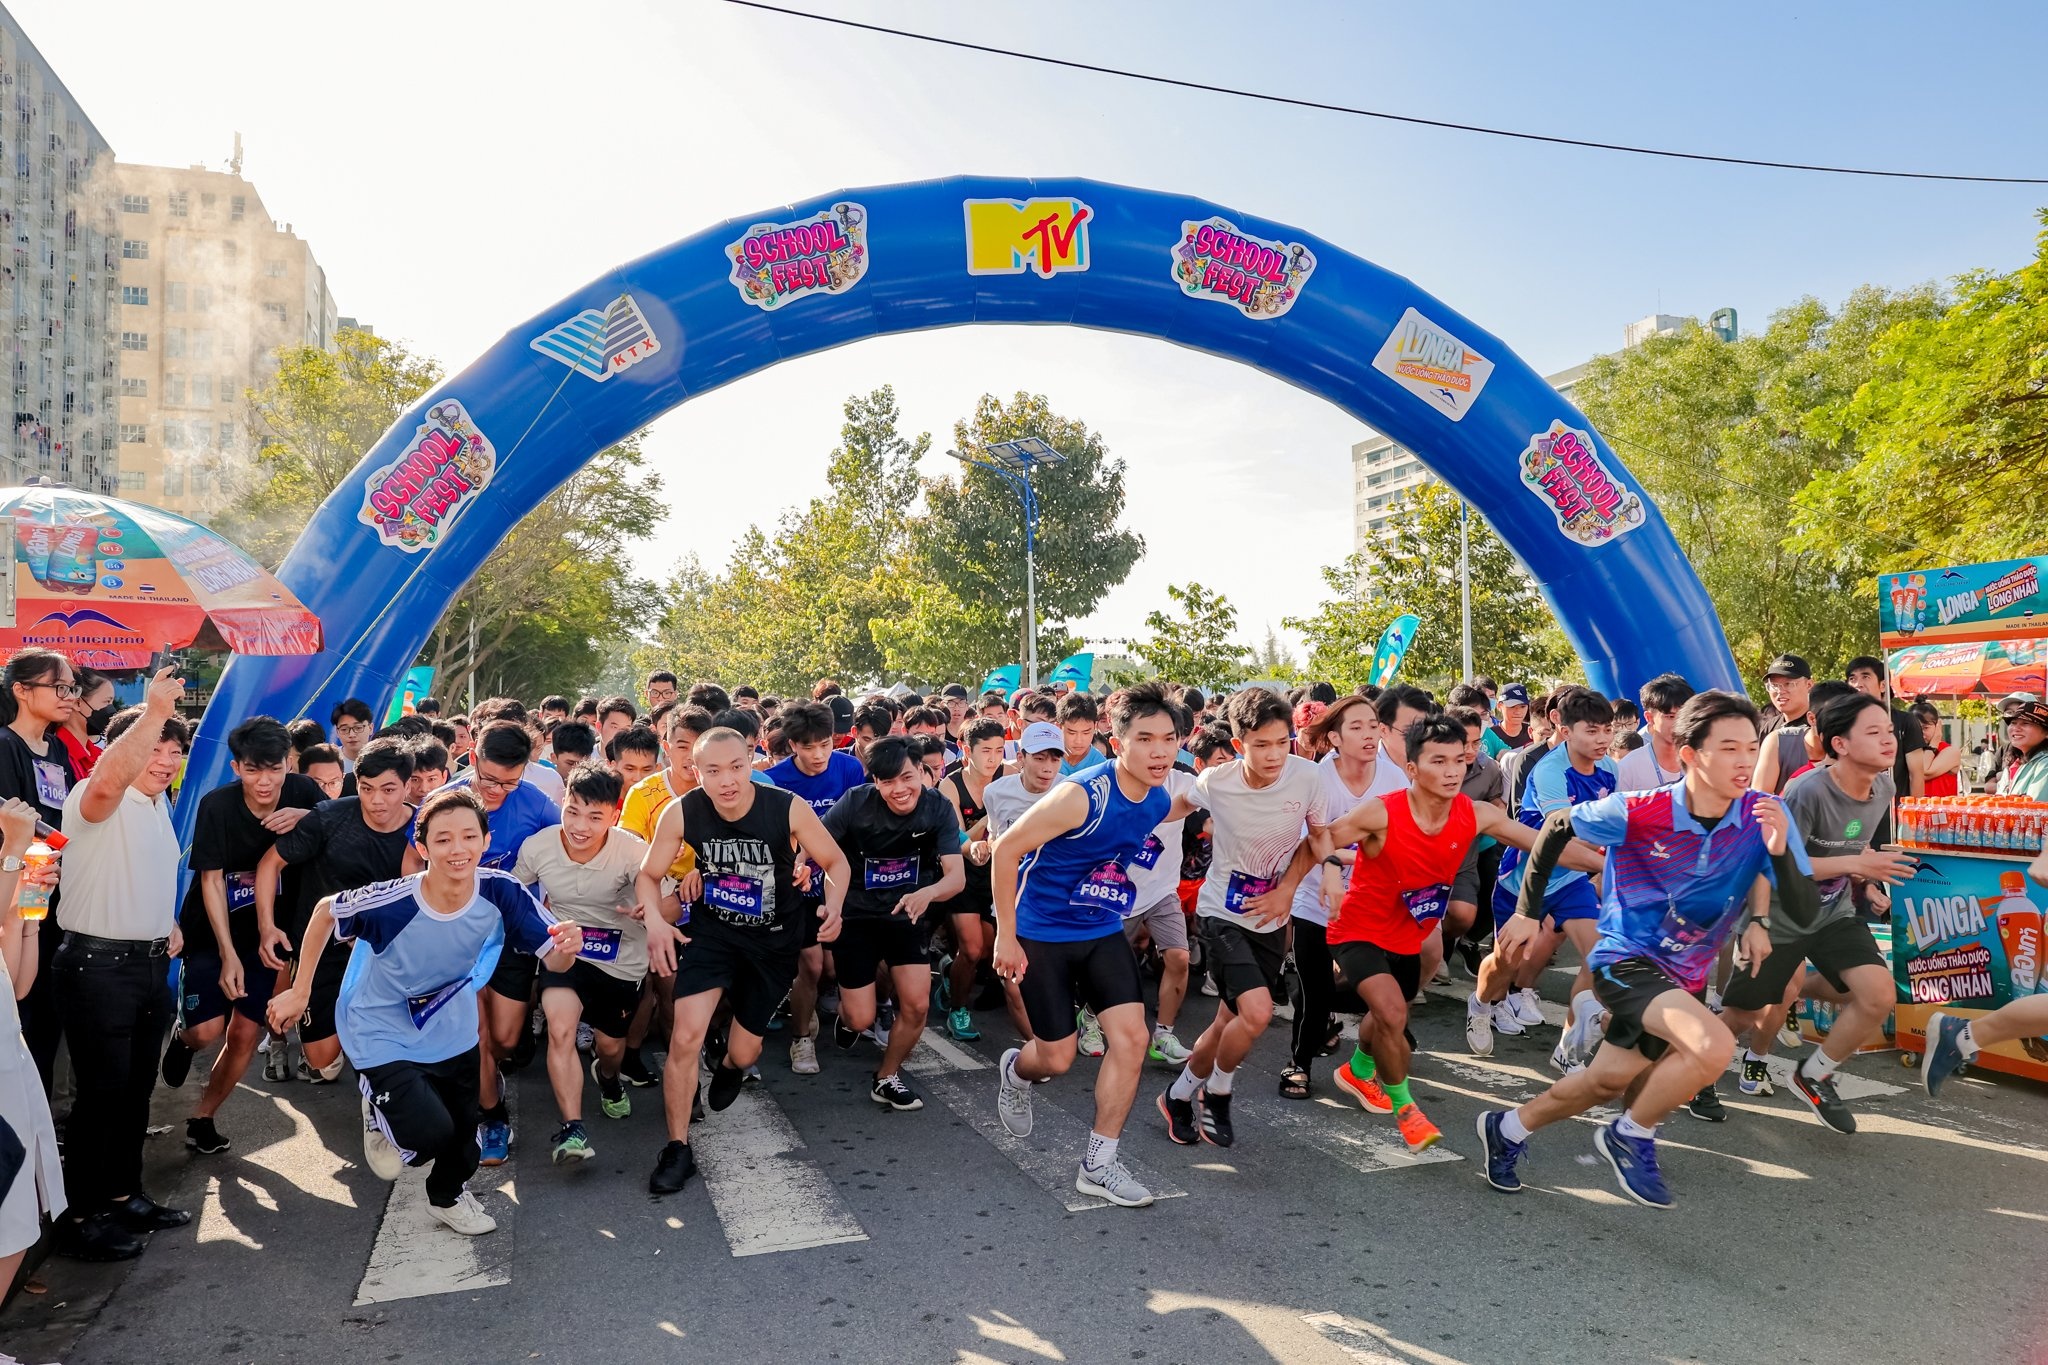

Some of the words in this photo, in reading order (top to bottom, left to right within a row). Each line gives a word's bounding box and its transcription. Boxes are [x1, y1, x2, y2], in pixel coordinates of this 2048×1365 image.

[744, 220, 851, 271] SCHOOL
[969, 202, 1088, 273] MTV
[1195, 225, 1289, 286] SCHOOL
[771, 253, 832, 296] FEST
[1201, 259, 1262, 306] FEST
[613, 338, 654, 366] KTX
[1400, 321, 1464, 372] LONGA
[370, 427, 467, 519] SCHOOL
[1551, 432, 1623, 524] SCHOOL
[410, 461, 473, 526] FEST
[1538, 465, 1593, 522] FEST
[1937, 590, 1980, 626] LONGA
[1987, 589, 2012, 610] LONG
[702, 842, 774, 865] NIRVANA
[1135, 850, 1153, 862] 31
[872, 871, 911, 883] F0936
[1080, 884, 1128, 906] F0834
[712, 887, 756, 907] F0669
[1904, 895, 1986, 950] LONGA
[581, 941, 612, 954] 690
[1907, 957, 1928, 974] NƯỚC
[1927, 952, 1948, 970] UỐNG
[1947, 949, 1968, 967] THẢO
[1967, 948, 1990, 967] DƯỢC
[1910, 977, 1950, 1003] LONG
[1950, 968, 1993, 999] NHÃN
[1911, 1027, 1927, 1037] MAD
